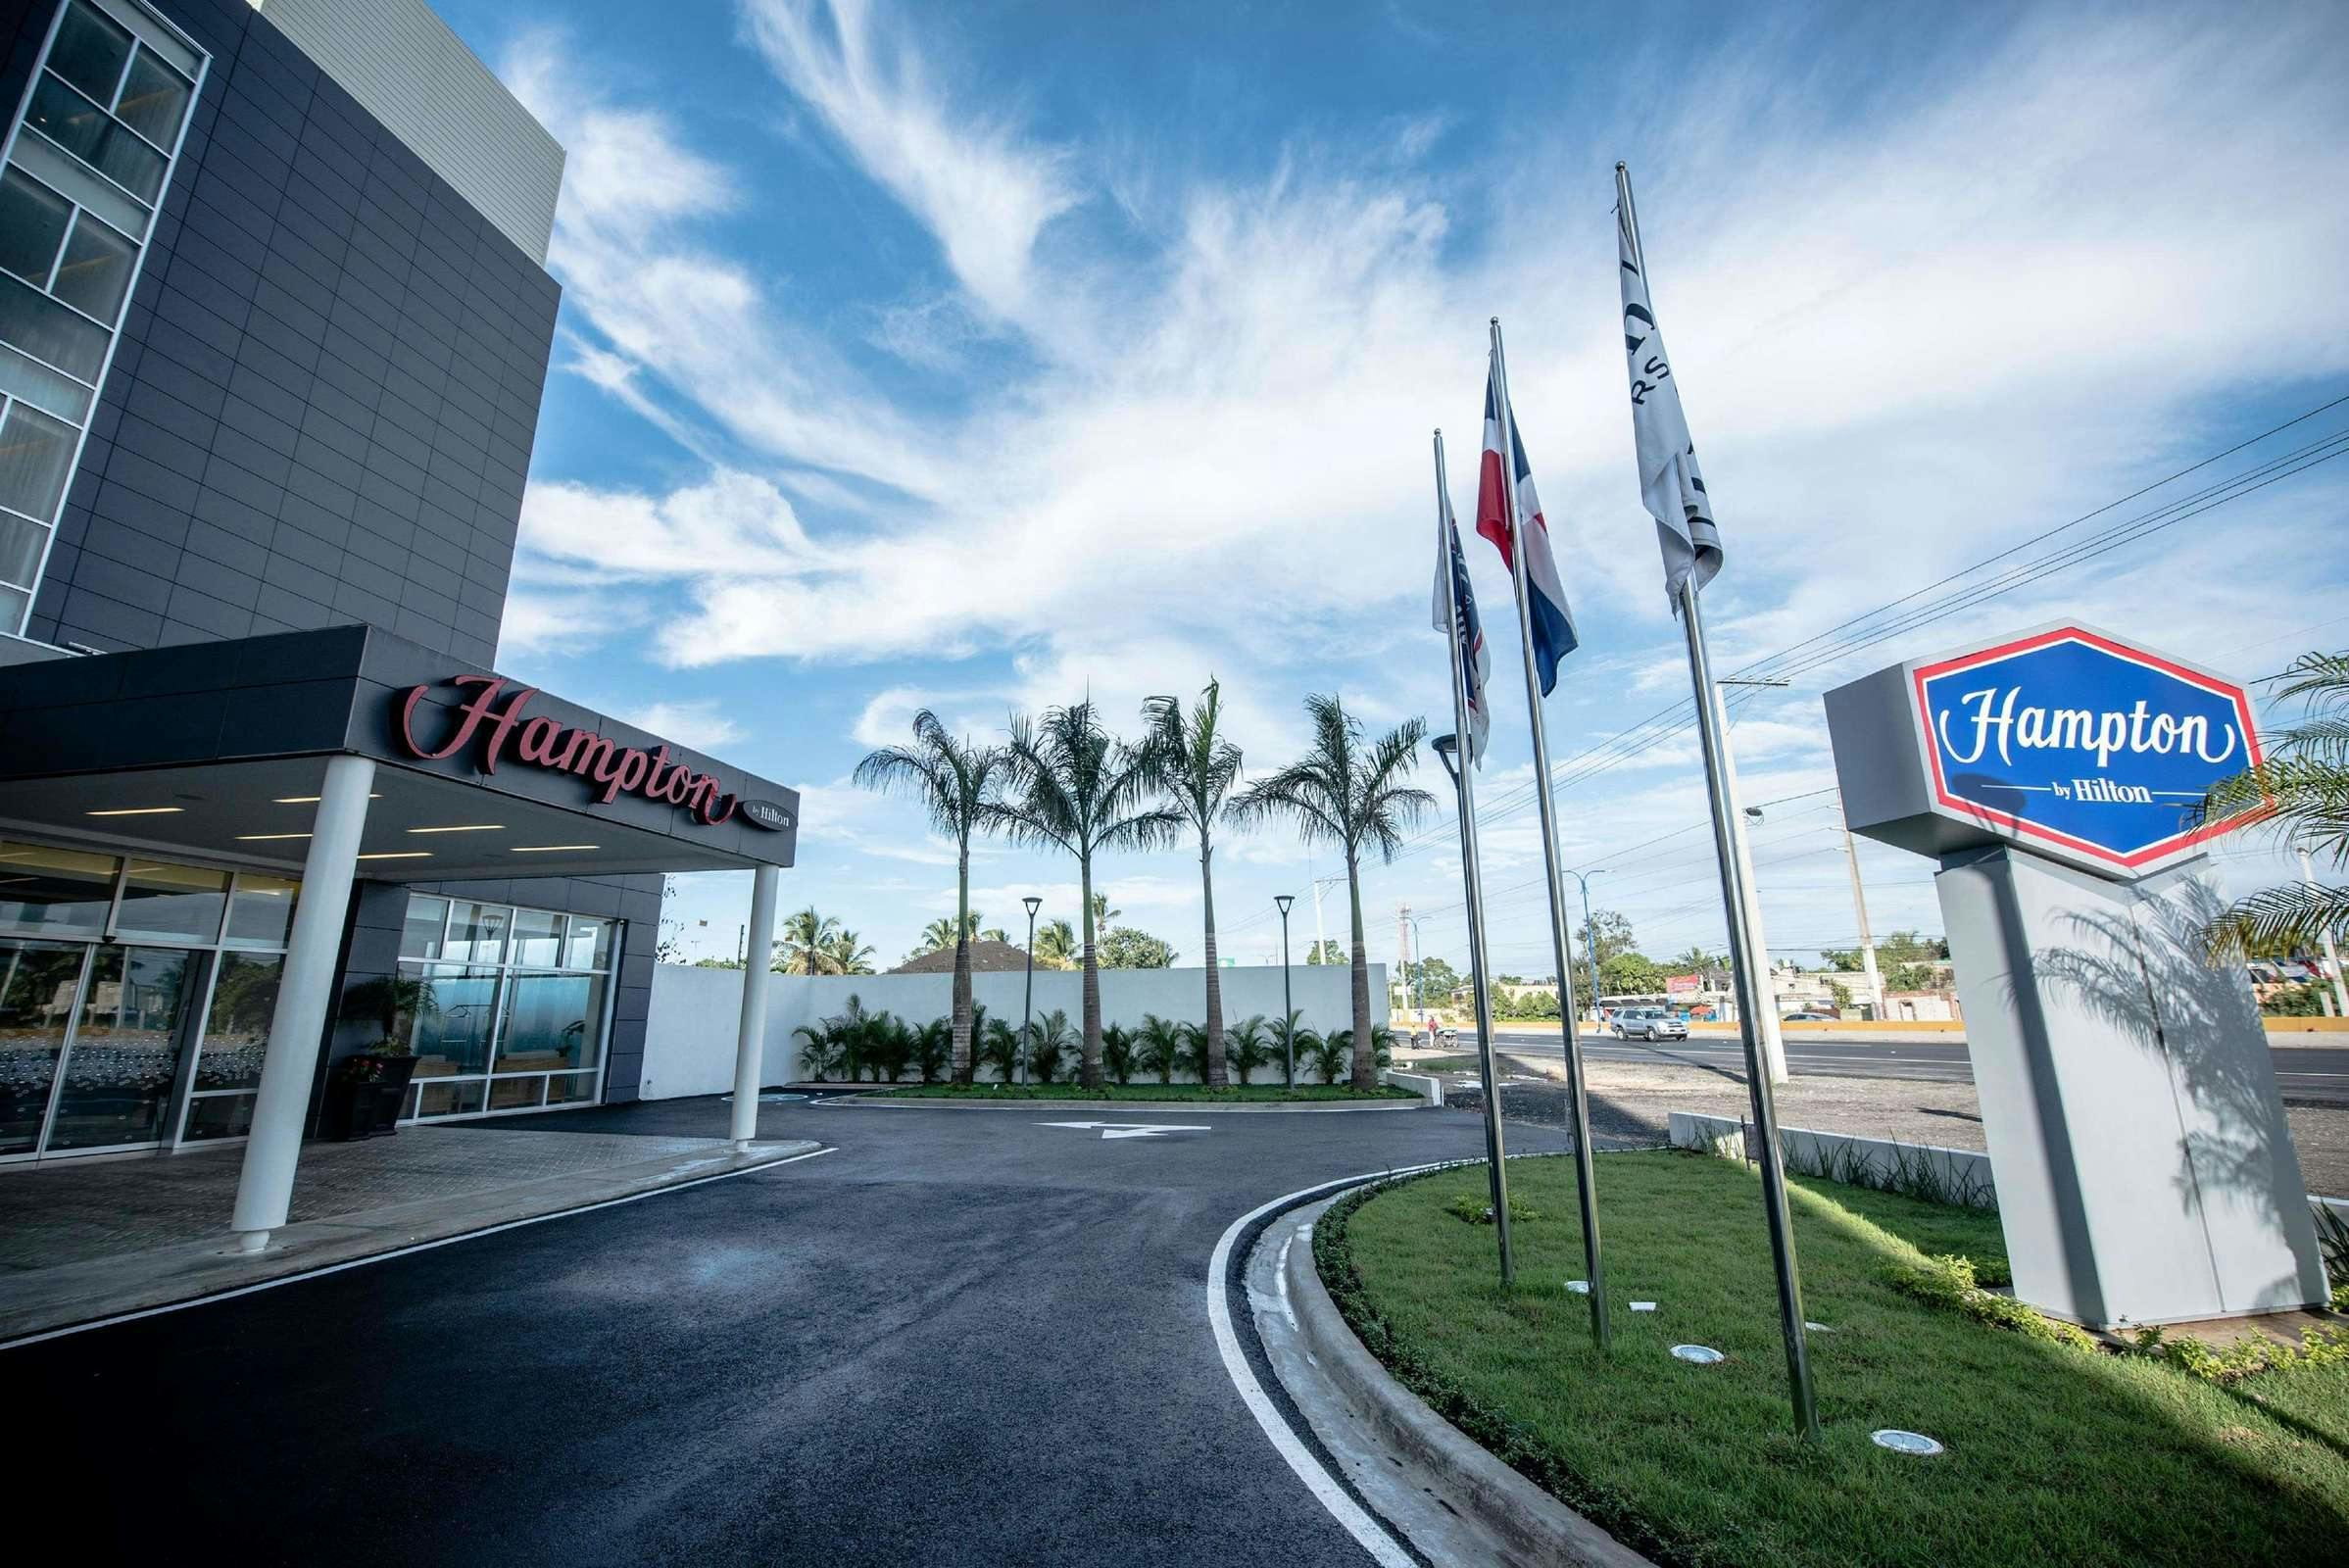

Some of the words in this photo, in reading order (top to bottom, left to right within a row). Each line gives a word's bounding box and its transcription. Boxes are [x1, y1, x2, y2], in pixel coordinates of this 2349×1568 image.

[402, 674, 737, 826] Hampton
[1938, 685, 2236, 768] Hampton
[752, 804, 759, 816] by
[759, 806, 790, 827] Hilton
[2051, 781, 2071, 801] by
[2071, 777, 2154, 804] Hilton
